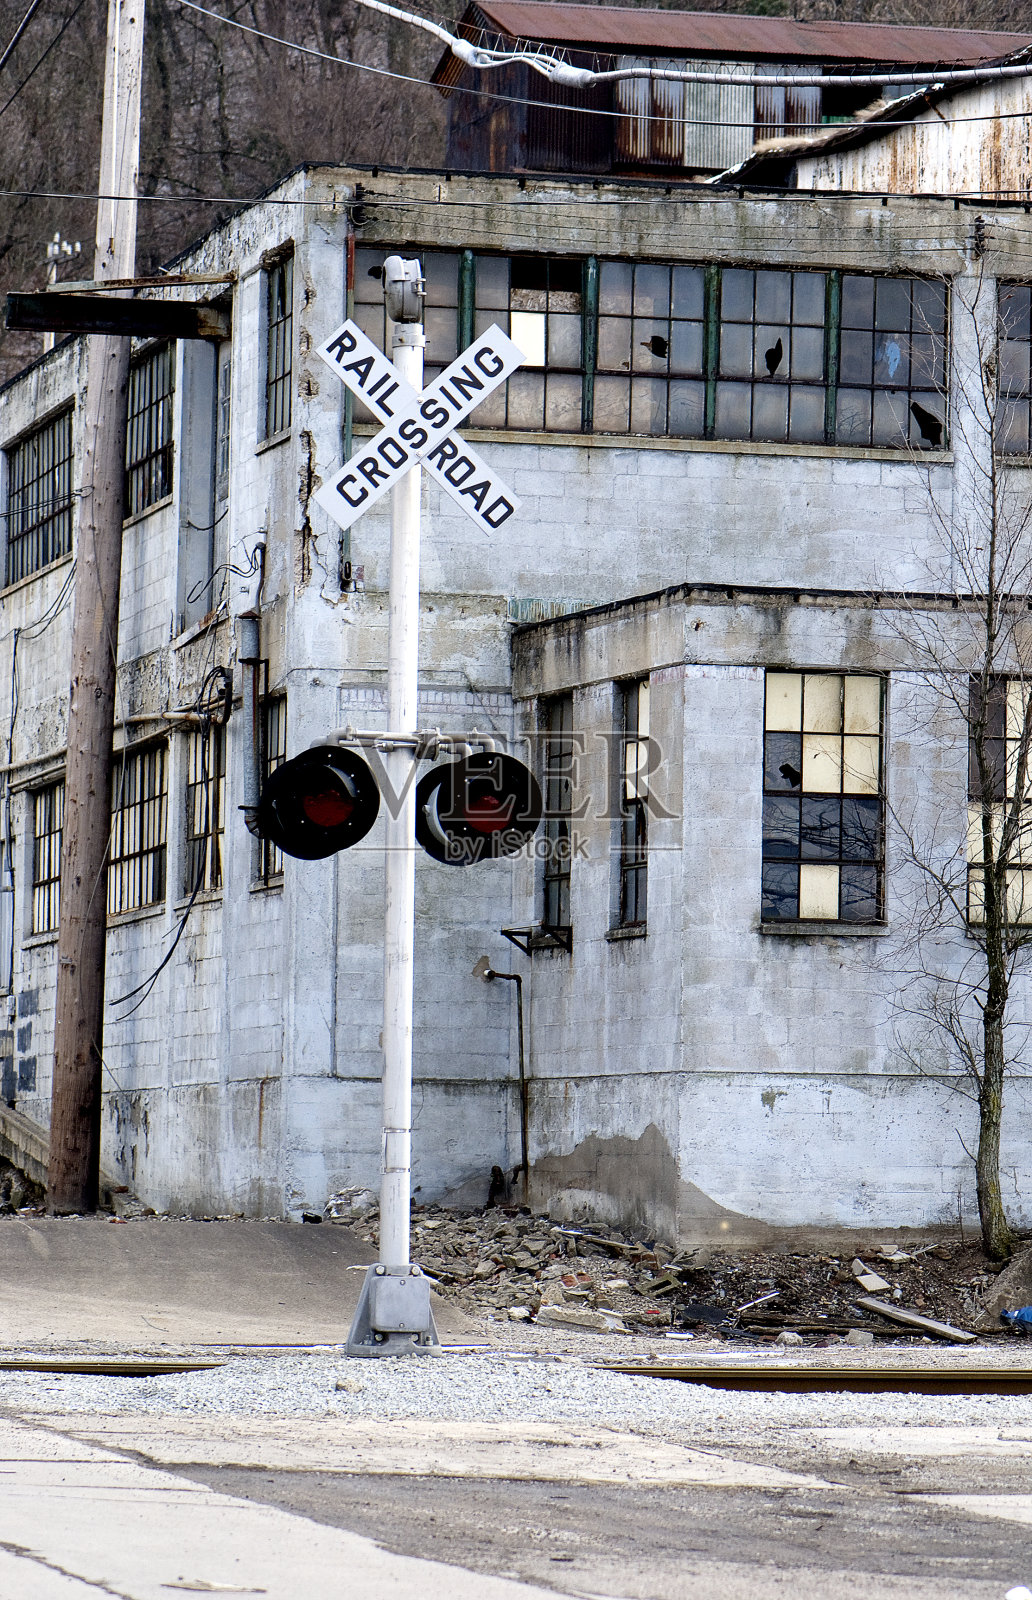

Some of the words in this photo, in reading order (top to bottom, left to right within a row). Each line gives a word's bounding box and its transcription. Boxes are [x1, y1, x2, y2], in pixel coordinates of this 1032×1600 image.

[326, 330, 399, 418] RAIL
[427, 437, 514, 528] ROAD
[336, 347, 504, 507] CROSSING
